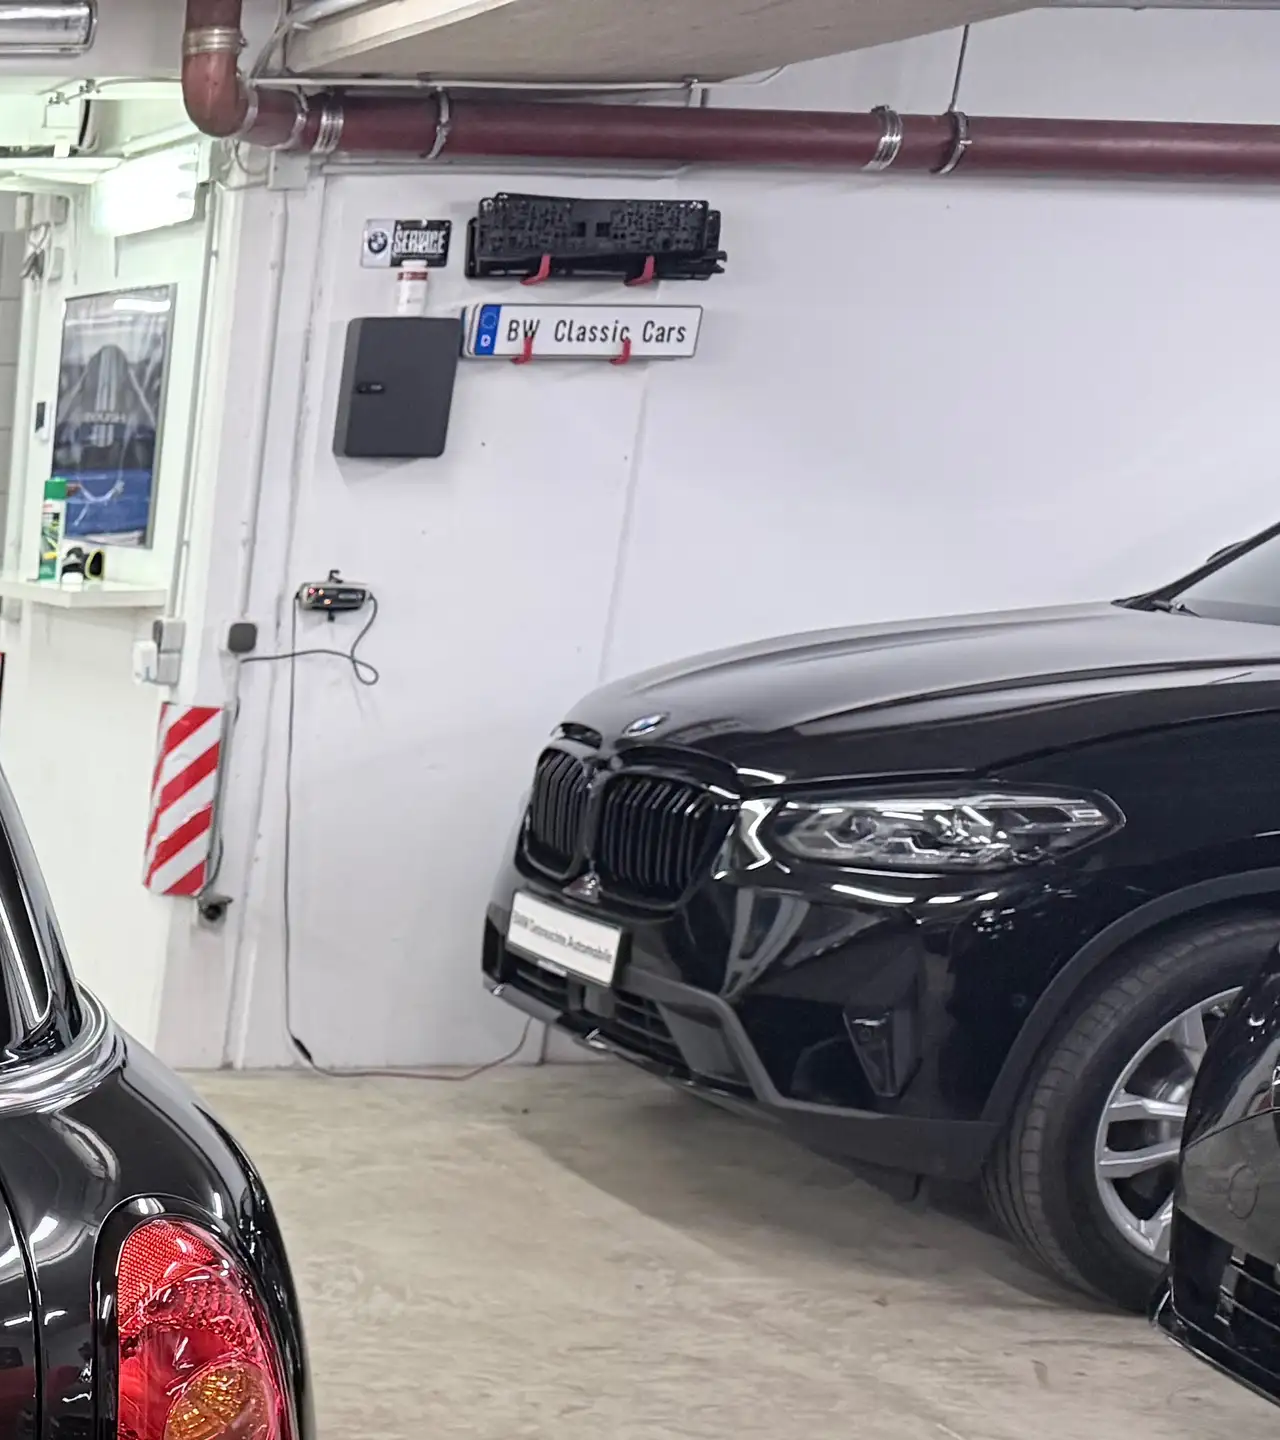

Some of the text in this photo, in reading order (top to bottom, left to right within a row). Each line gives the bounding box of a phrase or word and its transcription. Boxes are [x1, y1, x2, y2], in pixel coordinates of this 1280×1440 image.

[393, 229, 447, 254] SERVICE
[507, 319, 687, 342] BW Classic Cars
